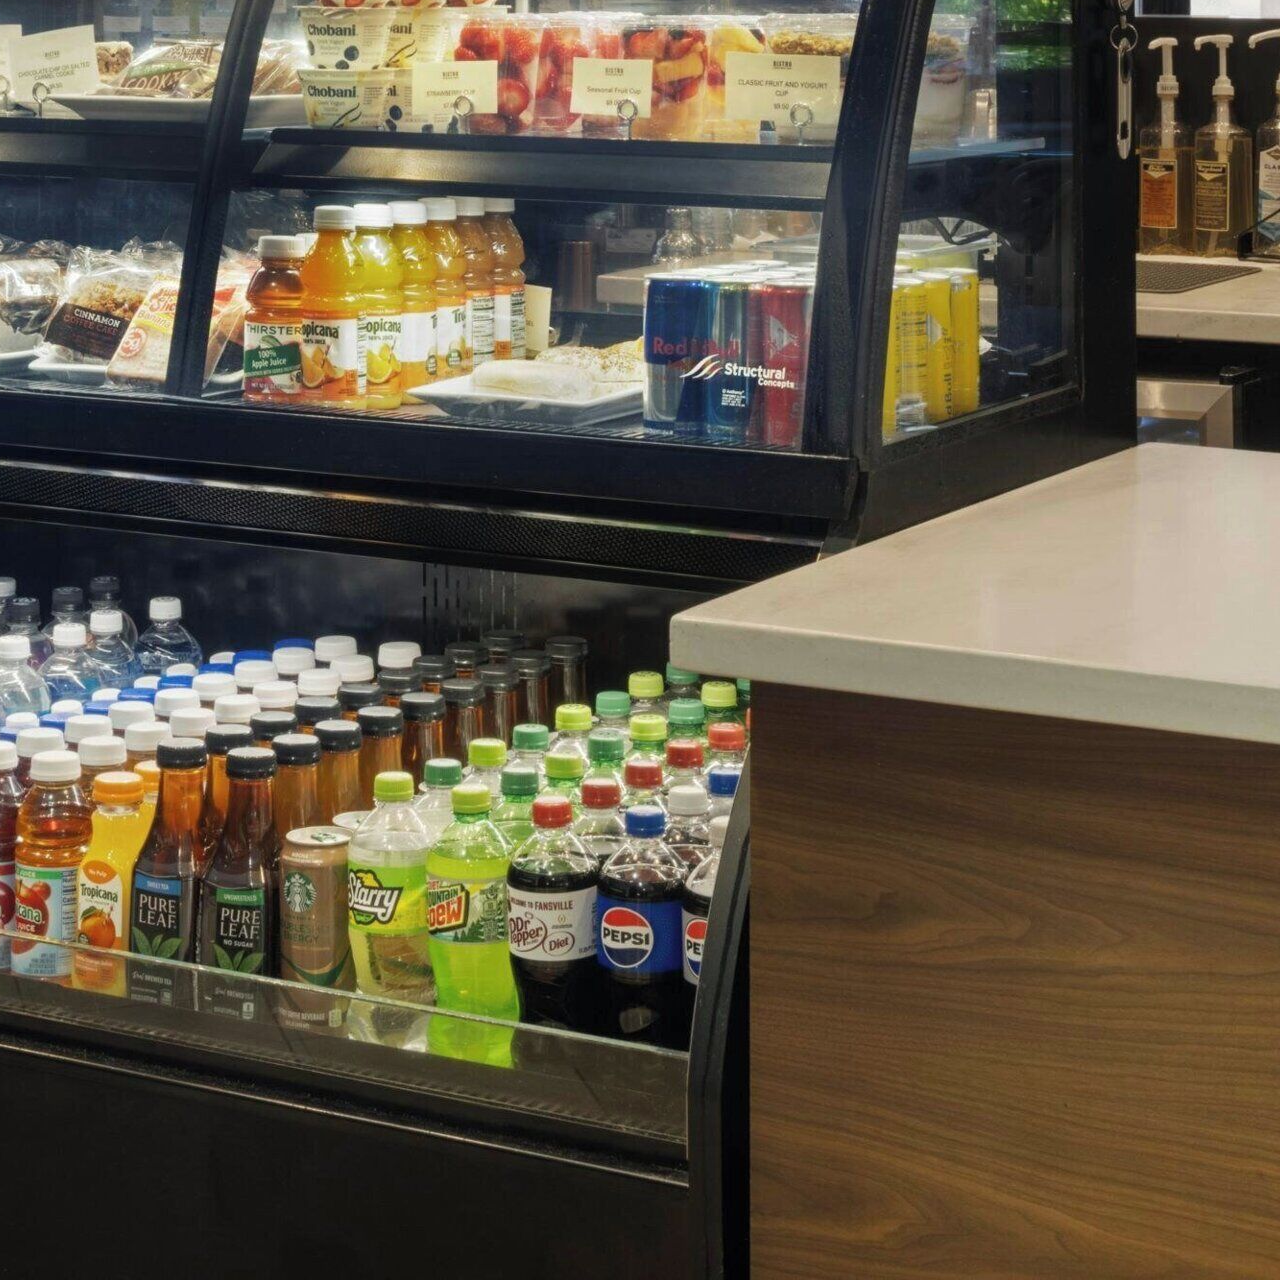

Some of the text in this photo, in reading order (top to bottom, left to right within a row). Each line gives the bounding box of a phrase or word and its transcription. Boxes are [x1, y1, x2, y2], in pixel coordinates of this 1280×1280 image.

[307, 23, 356, 37] Chobani
[307, 85, 357, 98] Chobani
[587, 86, 613, 94] Seasonal
[629, 87, 642, 96] Cup
[738, 79, 764, 87] CLASSIC
[801, 81, 828, 89] YOGURT
[74, 308, 120, 328] CINNAMON
[246, 323, 303, 336] THIRSTER
[302, 321, 340, 339] opicana
[365, 319, 402, 334] opicana
[258, 349, 277, 358] 100%
[653, 337, 687, 355] Red
[252, 357, 287, 369] Apple Juice
[724, 362, 787, 380] Structural
[758, 378, 795, 389] Concepts
[80, 883, 119, 903] Tropicana
[223, 893, 257, 902] UNSWEETENED
[348, 870, 399, 923] Starry
[139, 893, 176, 914] PURE
[534, 899, 573, 911] FANSVILLE
[139, 908, 175, 929] LEAF
[221, 907, 261, 925] PURE
[220, 923, 259, 939] LEAF
[603, 926, 650, 945] PEPSI
[233, 940, 254, 948] SUGAR
[548, 936, 569, 951] Diet
